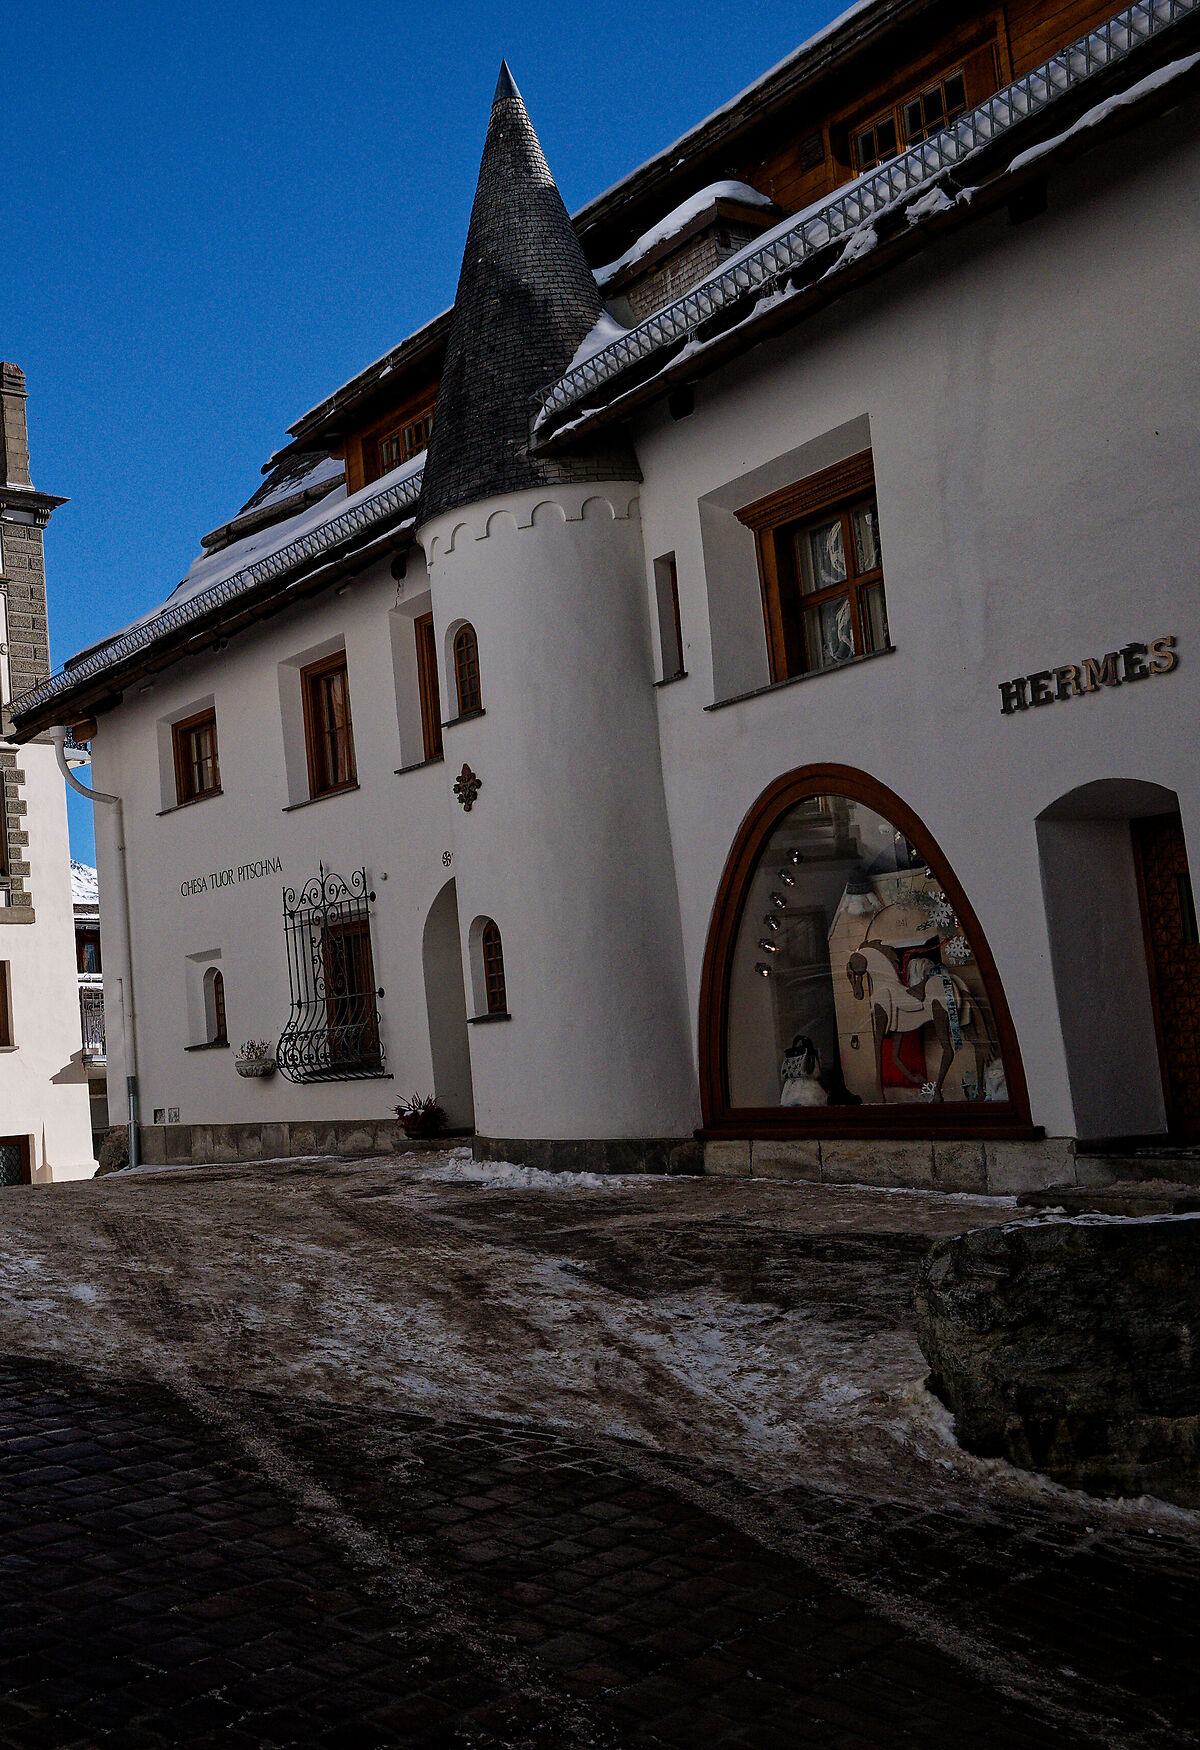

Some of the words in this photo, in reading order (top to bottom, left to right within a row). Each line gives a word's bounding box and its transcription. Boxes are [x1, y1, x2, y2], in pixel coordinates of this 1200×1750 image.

[181, 877, 207, 897] CHESA
[209, 868, 235, 889] TUOR
[237, 856, 282, 882] PITSCHNA
